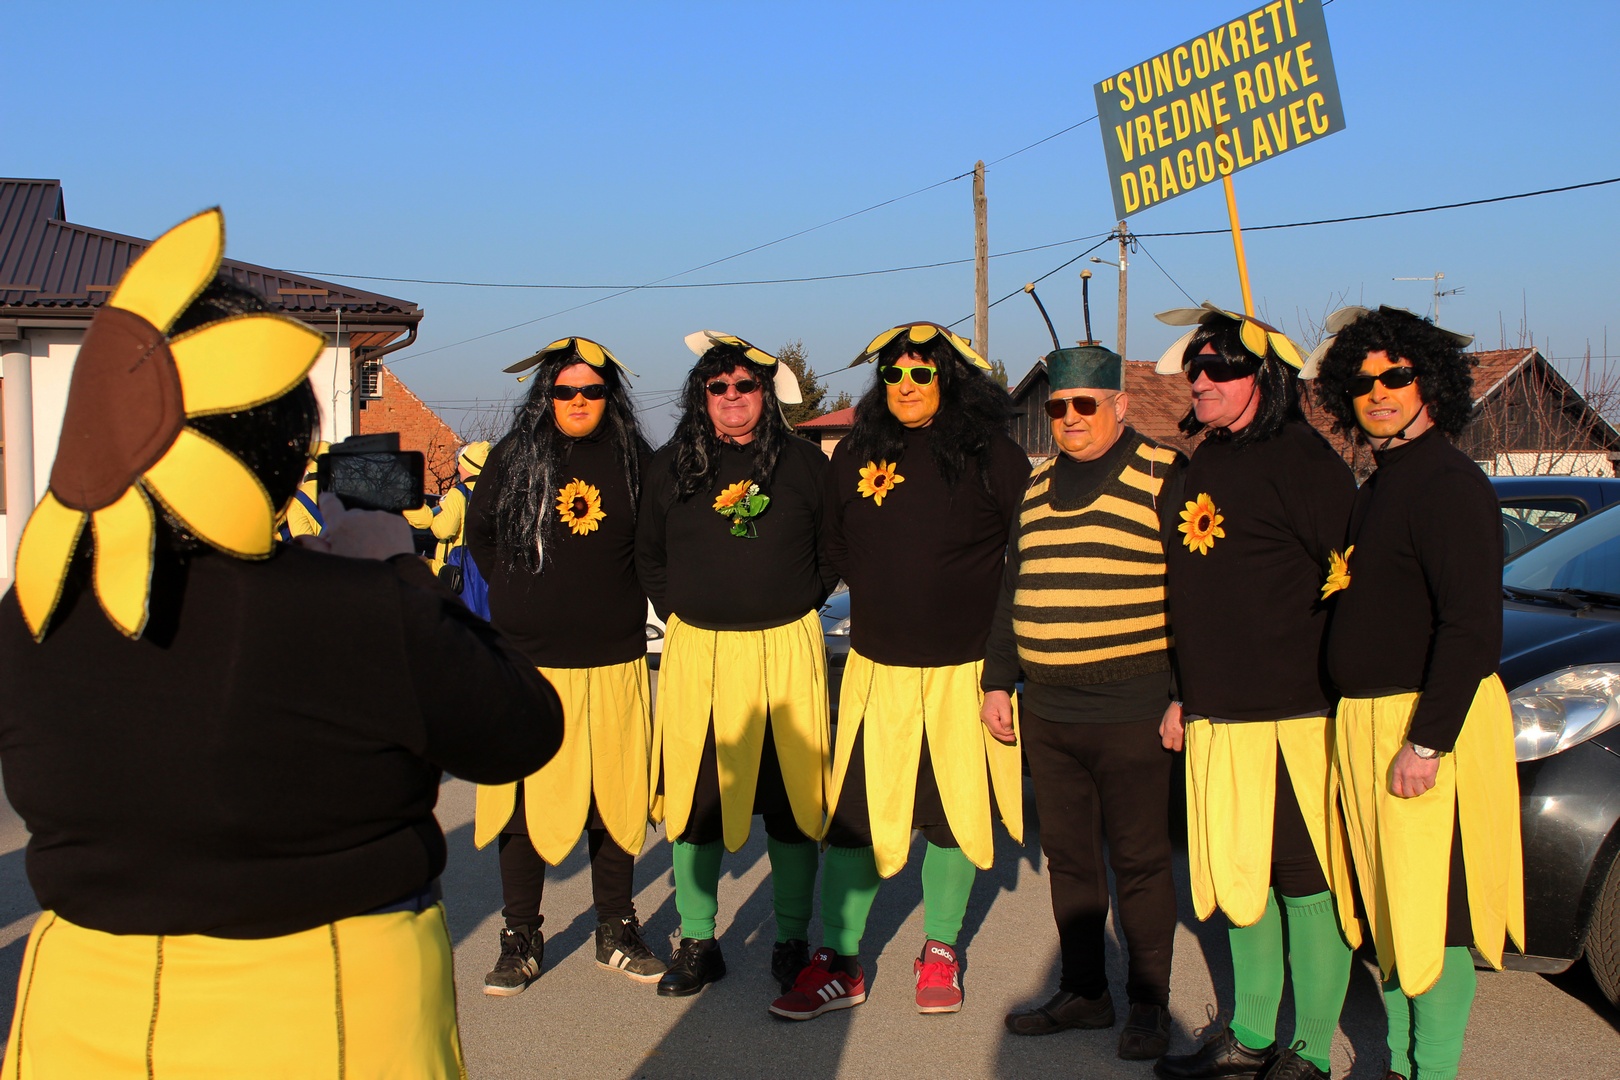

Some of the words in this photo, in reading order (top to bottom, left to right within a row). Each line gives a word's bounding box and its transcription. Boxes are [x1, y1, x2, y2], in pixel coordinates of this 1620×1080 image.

[1115, 80, 1231, 163] VREDNE
[1233, 41, 1319, 114] ROKE
[1120, 91, 1329, 213] DRAGOSLAVEC
